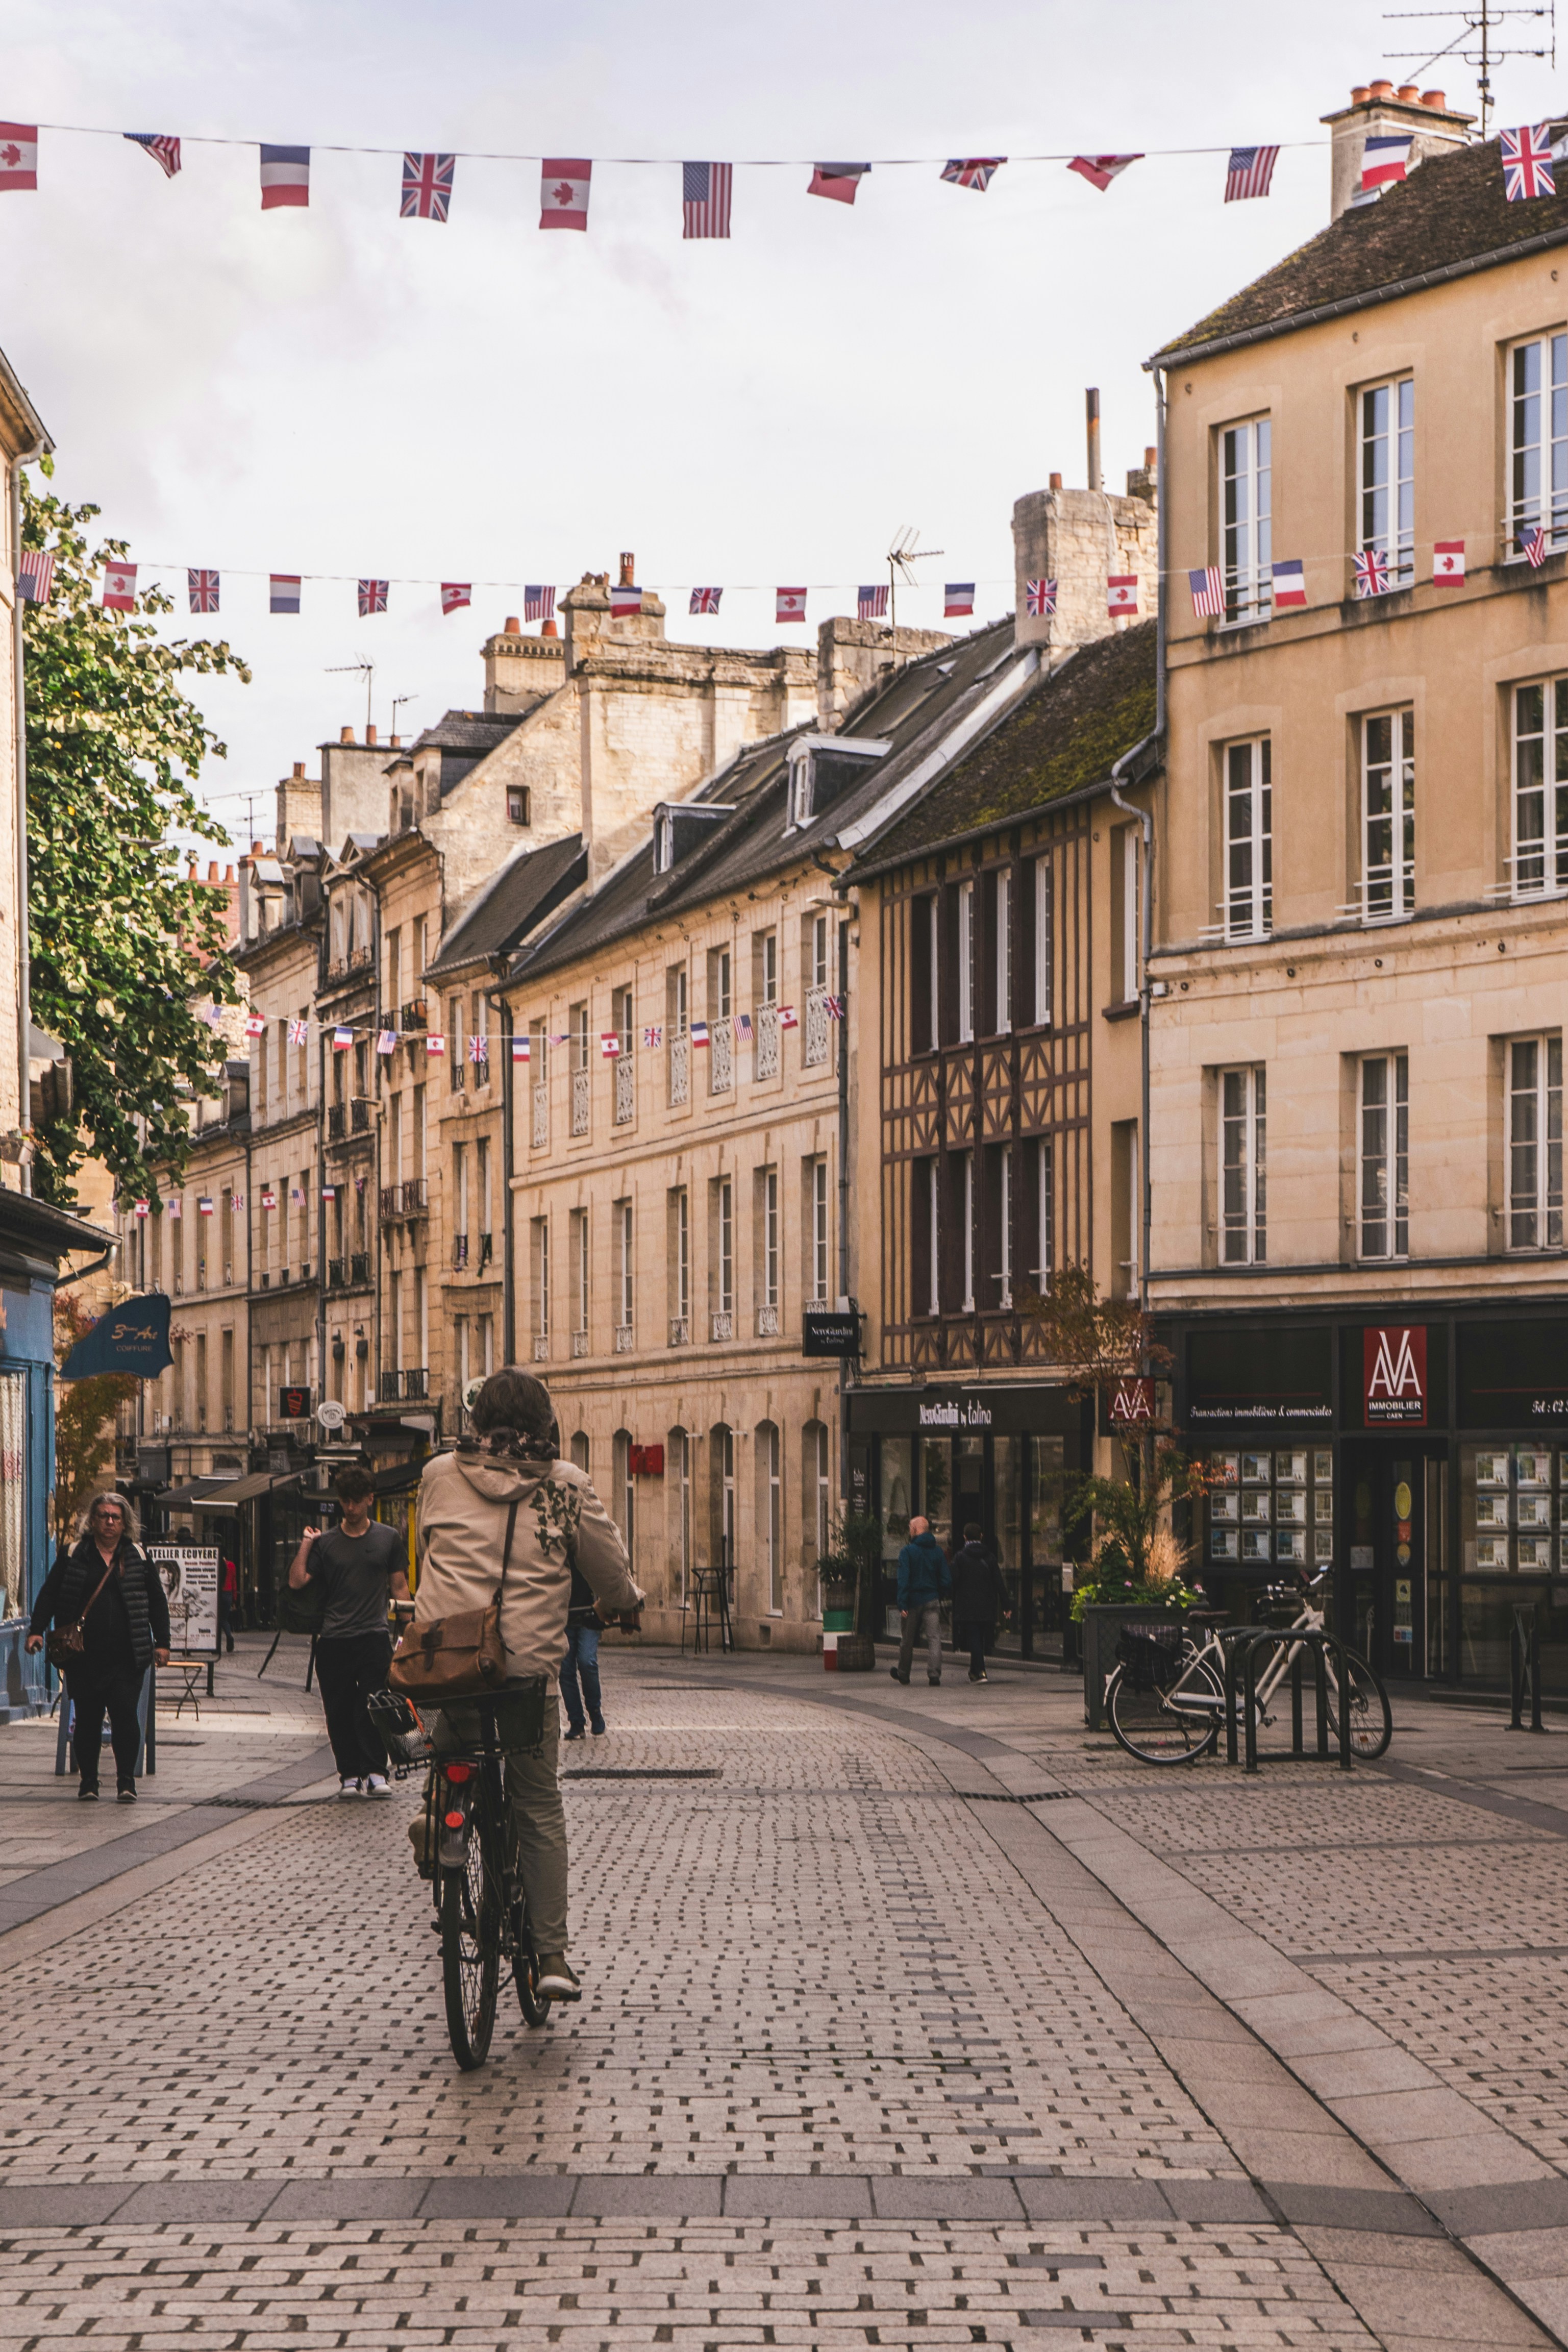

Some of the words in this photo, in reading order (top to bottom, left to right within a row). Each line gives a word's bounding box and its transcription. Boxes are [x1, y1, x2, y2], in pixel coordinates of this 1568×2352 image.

[134, 1325, 158, 1340] Art
[812, 1326, 853, 1335] NeroGiardini
[1368, 1330, 1423, 1397] AVA
[1110, 1379, 1151, 1419] AVA
[1368, 1401, 1421, 1410] IMMOBILIER
[919, 1401, 959, 1425] NeroGiardini
[968, 1399, 991, 1425] talina
[1190, 1406, 1233, 1418] Transactions
[1286, 1404, 1332, 1417] commerciales
[1553, 1400, 1563, 1413] 02
[148, 1549, 179, 1559] ATELIER
